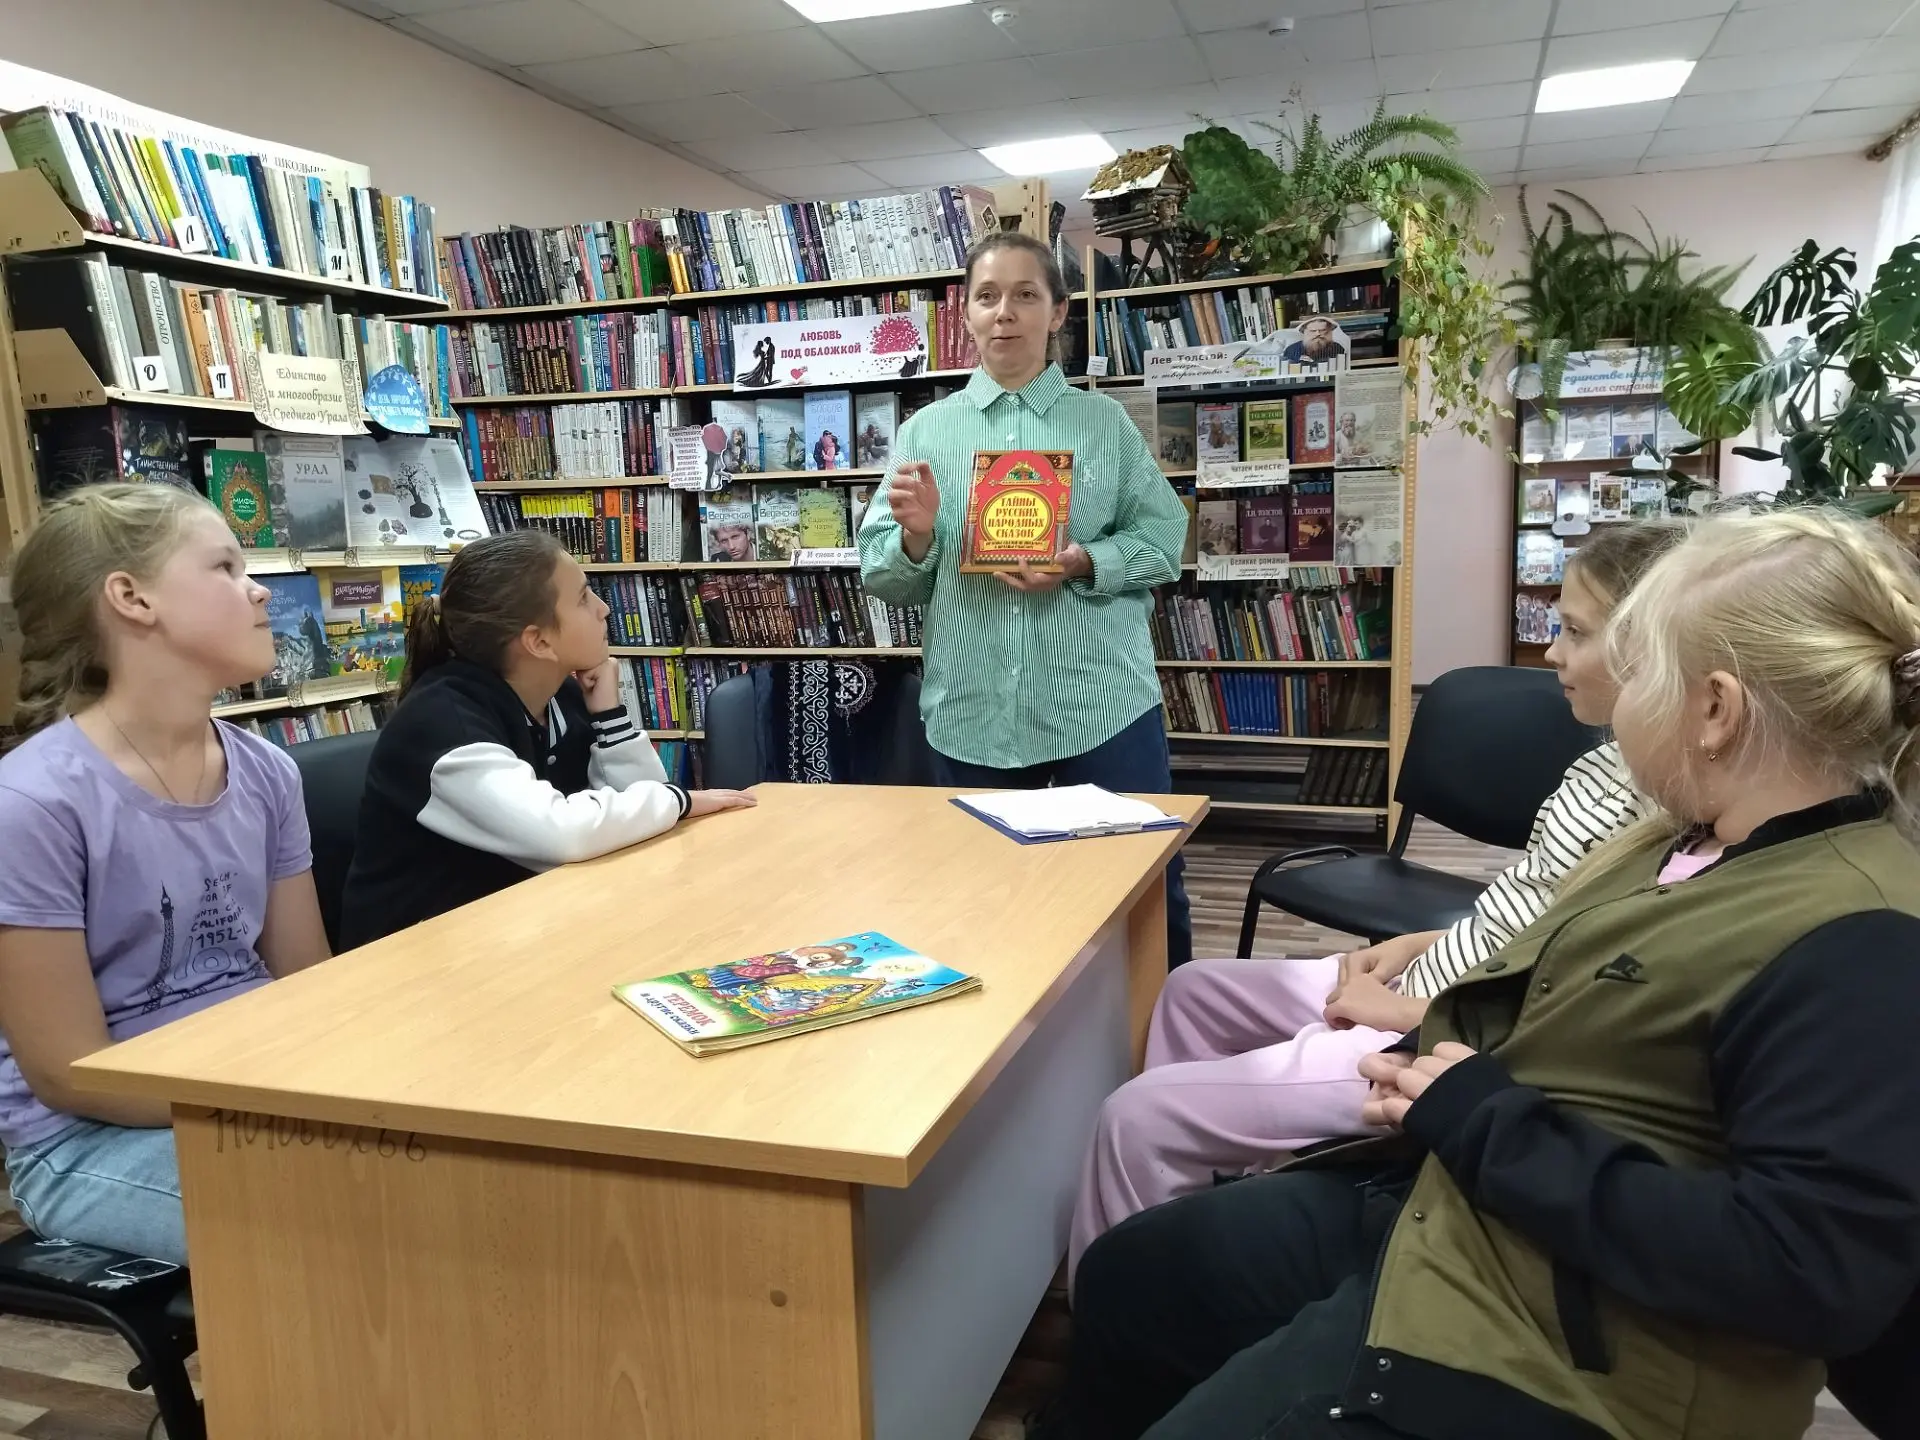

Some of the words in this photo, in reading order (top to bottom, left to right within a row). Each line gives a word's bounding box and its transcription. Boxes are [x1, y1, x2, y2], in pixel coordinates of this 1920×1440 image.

[186, 225, 195, 244] Л
[331, 255, 342, 271] М
[402, 265, 409, 280] Н
[150, 281, 170, 345] ОТРОЧЕСТВО
[800, 330, 842, 341] ЛЮБОВЬ
[780, 348, 802, 359] ПОД
[804, 342, 861, 357] ОБЛОЖКОЙ
[1151, 356, 1172, 365] Лев
[144, 364, 157, 381] О
[276, 367, 327, 382] Единство
[216, 372, 227, 389] П
[268, 389, 275, 398] и
[277, 388, 343, 405] многообразие
[1577, 386, 1606, 394] сила
[273, 408, 316, 423] Среднего
[317, 410, 349, 426] Урала
[296, 463, 329, 475] УРАЛ
[1001, 496, 1036, 506] ТАЙНЫ
[708, 511, 751, 521] Веденская
[995, 508, 1039, 517] РУССКИХ
[1258, 508, 1283, 516] ТОЛСТОЙ
[987, 518, 1045, 528] НАРОДНЫХ
[596, 513, 605, 549] ТОБОЛ
[996, 528, 1035, 538] СКАЗОК
[888, 612, 900, 644] СПЕЦНАЗ
[907, 612, 919, 645] СПЕЦНАЗ
[663, 993, 716, 1026] ТЕРЕМОК
